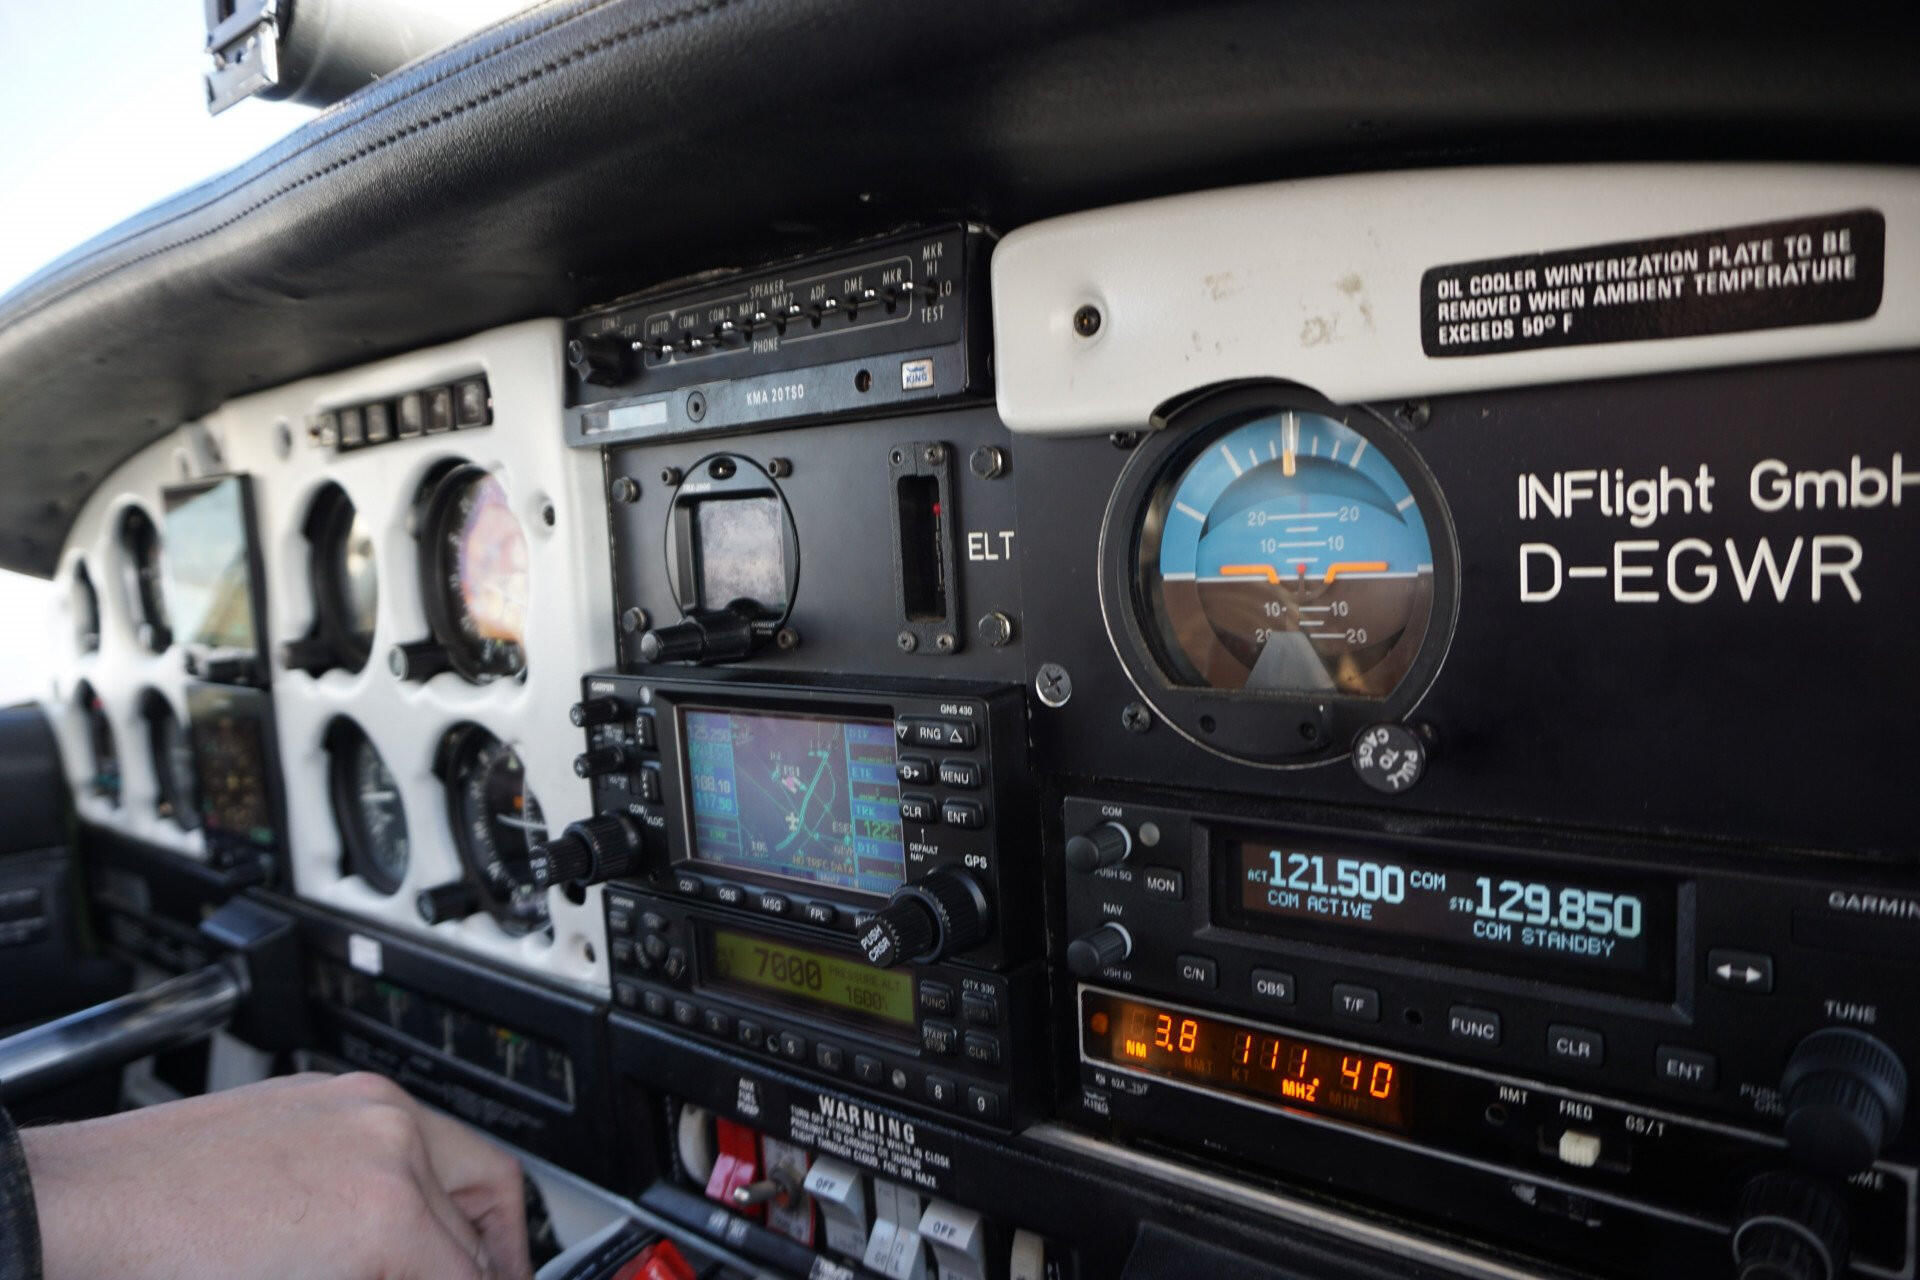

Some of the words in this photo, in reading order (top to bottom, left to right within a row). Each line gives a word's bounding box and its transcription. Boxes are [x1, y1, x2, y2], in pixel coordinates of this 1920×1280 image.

[922, 242, 943, 261] MKR
[926, 261, 938, 276] HI
[1437, 278, 1463, 299] OIL
[1470, 269, 1537, 296] COOLER
[1545, 248, 1698, 288] WINTERIZATION
[1709, 238, 1773, 269] PLATE
[1784, 233, 1812, 260] TO
[1823, 228, 1851, 255] BE
[844, 275, 863, 294] DME
[882, 267, 902, 286] MKR
[750, 279, 784, 299] SPEAKER
[810, 284, 826, 301] ADF
[939, 280, 952, 298] LO
[1438, 294, 1521, 323] REMOVED
[1528, 287, 1585, 313] WHEN
[1593, 275, 1684, 306] AMBIENT
[1694, 253, 1856, 296] TEMPERATURE
[739, 303, 754, 317] NAV
[771, 296, 787, 310] NAV
[679, 315, 694, 329] COM
[708, 308, 724, 323] COM
[921, 304, 944, 324] TEST
[651, 320, 668, 334] AUTO
[1438, 318, 1514, 346] EXCEEDS
[1563, 312, 1573, 334] F
[753, 337, 779, 354] PHONE
[906, 371, 928, 384] KING
[746, 388, 768, 406] KMA
[1518, 462, 1715, 528] INFlight
[1248, 511, 1266, 527] 20
[1338, 506, 1360, 522] 20
[968, 531, 1015, 561] ELT
[1260, 538, 1276, 553] 10
[1328, 536, 1344, 551] 10
[1519, 535, 1863, 603] D-EGWR
[1264, 602, 1280, 617] 10
[1331, 601, 1349, 617] 10
[1346, 629, 1367, 644] 20
[940, 703, 957, 716] GNS
[959, 705, 973, 716] 430
[919, 727, 941, 741] RNG
[940, 770, 969, 785] MENU
[902, 804, 922, 819] CLR
[947, 811, 968, 825] ENT
[1101, 805, 1122, 817] COM
[909, 842, 938, 855] DEFAULT
[964, 854, 987, 870] GPS
[679, 879, 693, 892] CDI
[1147, 876, 1175, 893] MON
[1247, 868, 1267, 883] ACT
[1269, 850, 1405, 904] 121.500
[1410, 870, 1446, 892] COM
[719, 888, 736, 902] OBS
[762, 898, 782, 912] MSG
[1103, 902, 1123, 916] NAV
[1268, 889, 1299, 910] COM
[1307, 895, 1373, 921] ACTIVE
[1449, 896, 1474, 913] STB
[1476, 876, 1641, 938] 129.850
[1829, 891, 1920, 920] GARMIN
[810, 907, 826, 921] FPL
[861, 924, 883, 950] PUSH
[1473, 920, 1512, 942] COM
[1522, 927, 1615, 958] STANDBY
[754, 947, 822, 991] 7000
[1183, 965, 1205, 982] C/N
[962, 978, 978, 991] GTX
[1257, 979, 1285, 998] OBS
[921, 995, 946, 1009] FUNC
[1343, 996, 1365, 1013] T/F
[1824, 999, 1877, 1025] TUNE
[923, 1024, 947, 1042] START
[1155, 1014, 1198, 1053] 3.8
[1451, 1017, 1495, 1040] FUNC
[1126, 1039, 1147, 1058] NM
[1556, 1038, 1590, 1058] CLR
[1666, 1058, 1704, 1081] ENT
[1500, 1086, 1528, 1105] RMT
[1559, 1100, 1593, 1121] FREQ
[819, 1094, 915, 1145] WARNING
[1625, 1115, 1665, 1137] GS/T
[857, 1127, 884, 1146] LIGHTS
[925, 1150, 950, 1169] CLOSE
[815, 1178, 835, 1192] OFF
[915, 1172, 937, 1189] HAZE
[932, 1220, 956, 1238] OFF
